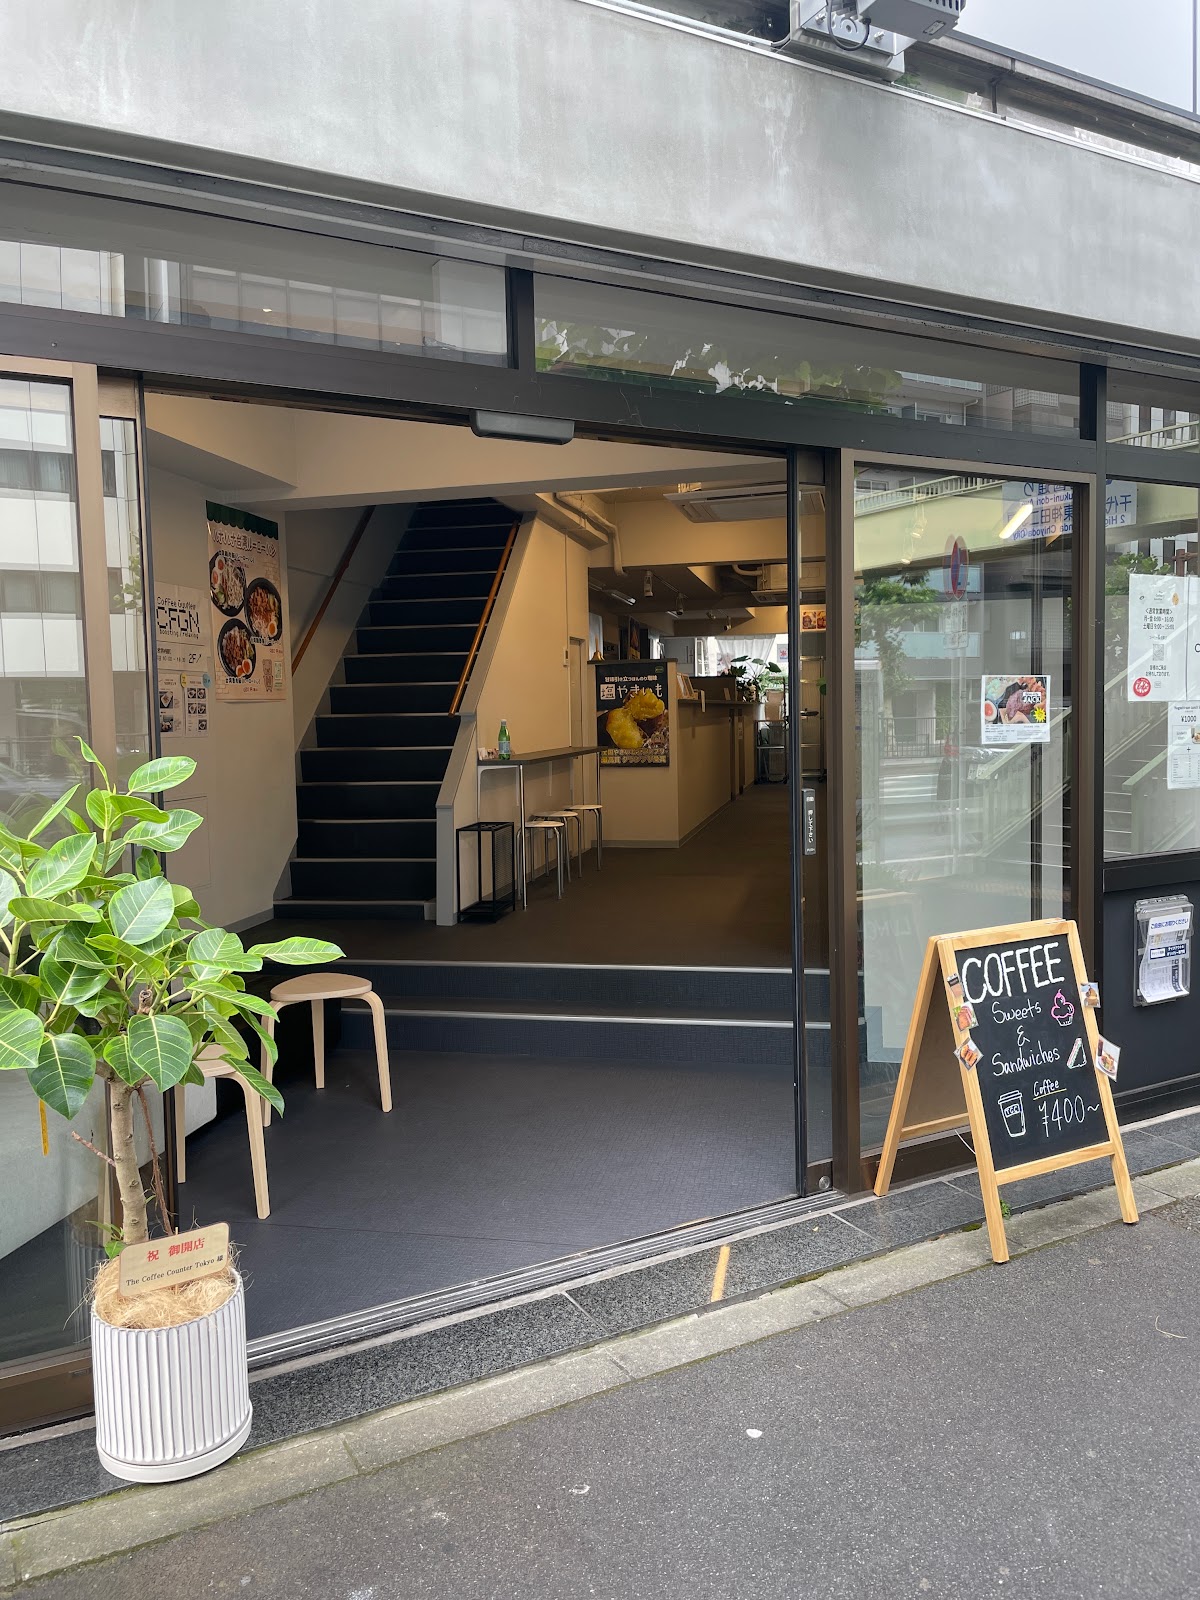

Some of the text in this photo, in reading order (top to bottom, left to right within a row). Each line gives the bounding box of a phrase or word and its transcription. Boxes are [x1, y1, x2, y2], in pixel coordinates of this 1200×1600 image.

[156, 606, 201, 634] CFGN
[961, 941, 1066, 1004] COFFEE
[991, 998, 1042, 1024] Sweets
[1016, 1024, 1031, 1047] &
[991, 1039, 1061, 1077] Sandwiches
[1032, 1078, 1060, 1097] Coffee
[146, 1237, 206, 1262] 祝 御開店
[126, 1254, 224, 1287] The Coffee Counter Tokyo 様
